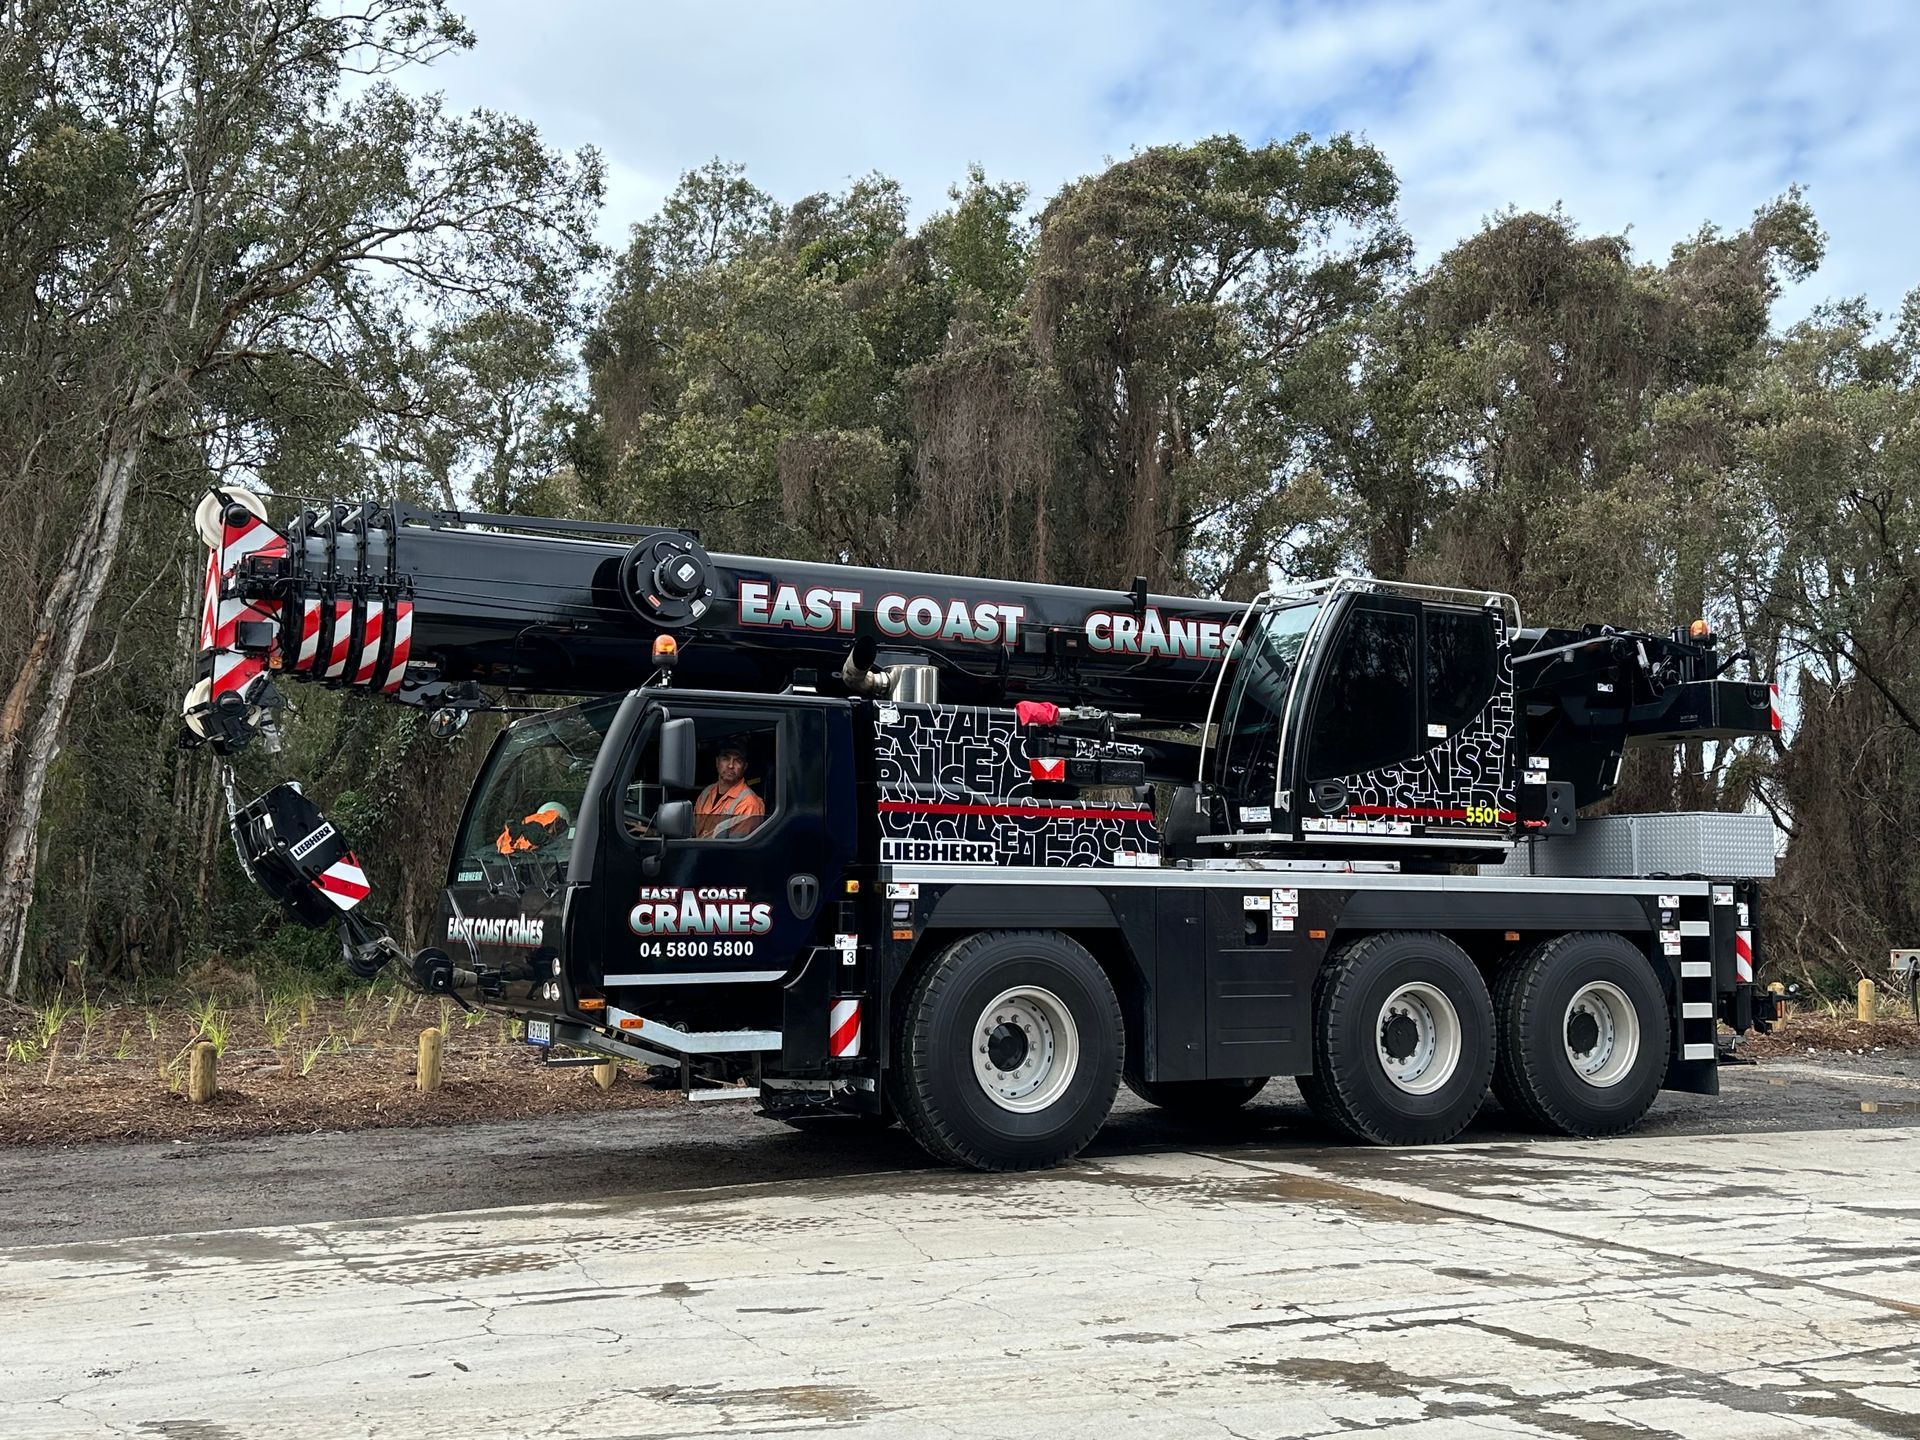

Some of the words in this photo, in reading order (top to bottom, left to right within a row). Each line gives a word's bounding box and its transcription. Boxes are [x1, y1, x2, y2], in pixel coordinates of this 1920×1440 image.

[740, 581, 862, 632] EAST
[875, 593, 1025, 644] COAST
[1084, 606, 1244, 660] CRANES
[1466, 807, 1499, 824] 5501
[292, 826, 332, 857] LIEBHERR
[881, 841, 995, 863] LIEBHERR
[640, 887, 679, 900] EAST
[698, 888, 747, 900] COAST
[629, 890, 772, 934] CRANES
[447, 917, 475, 942] EAST
[474, 917, 507, 943] COAST
[505, 912, 545, 946] CRANES
[639, 942, 662, 958] 04
[666, 941, 708, 957] 5800
[713, 940, 754, 956] 5800
[846, 951, 855, 964] 3
